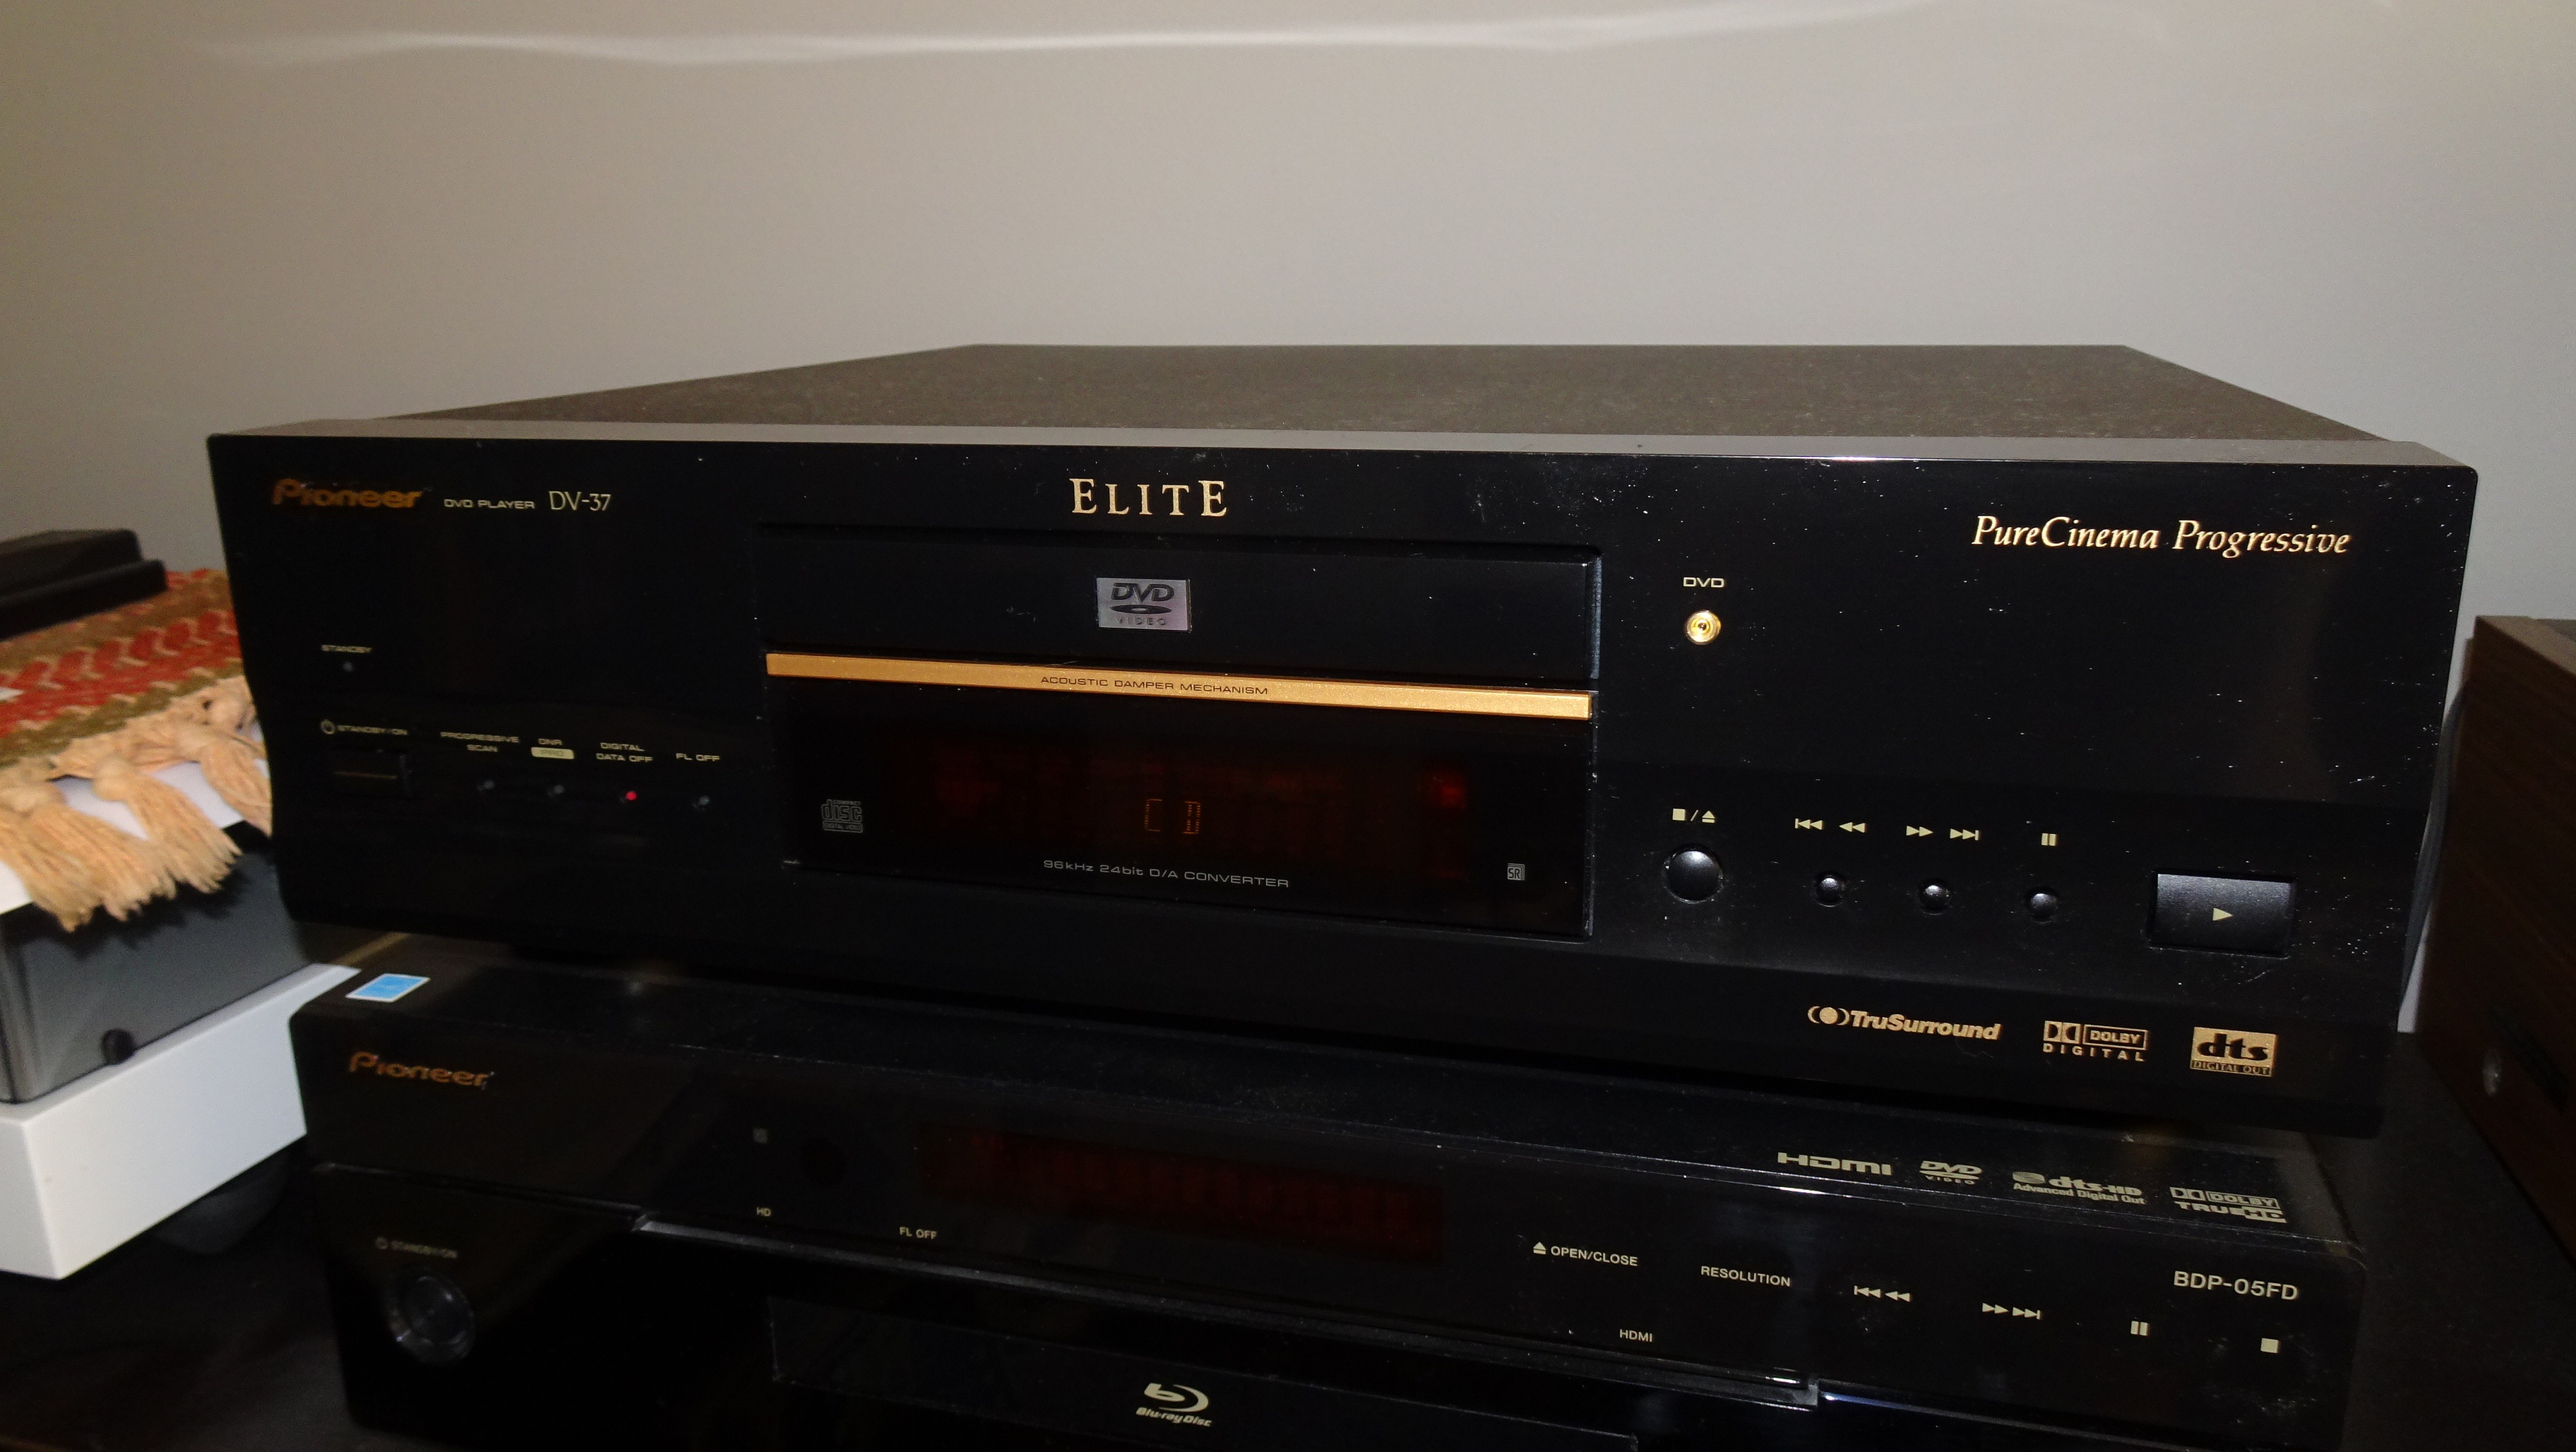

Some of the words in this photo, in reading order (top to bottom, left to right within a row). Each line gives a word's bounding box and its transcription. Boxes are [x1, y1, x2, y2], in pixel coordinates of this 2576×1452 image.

[271, 477, 422, 508] Pioneer
[549, 490, 612, 511] DV-37
[1069, 478, 1227, 517] ELITE
[444, 499, 473, 508] DVD
[477, 499, 535, 509] PLAYER
[1972, 516, 2160, 549] PureCinema
[2171, 520, 2351, 559] Progressive
[1683, 577, 1725, 588] DVD
[1111, 583, 1174, 603] DVD
[1115, 616, 1167, 626] VIDEO
[321, 644, 372, 654] STANDBY
[1041, 676, 1109, 687] ACOUSTIC
[1114, 680, 1174, 691] DAMPER
[1180, 683, 1268, 696] MECHANISM
[440, 732, 520, 743] PROGRESSIVE
[466, 744, 499, 753] SCAN
[600, 742, 645, 752] DIGITAL
[595, 753, 626, 761] DATA
[675, 752, 693, 761] FL
[1044, 859, 1094, 871] 96kHz
[1099, 864, 1144, 876] 24bit
[1149, 868, 1179, 879] D/A
[1183, 871, 1289, 888] CONVERTER
[1851, 1010, 2002, 1041] TruSurround
[2089, 1029, 2142, 1045] DOLBY
[2042, 1042, 2145, 1062] DIGITAL
[2197, 1033, 2268, 1061] dts
[350, 1051, 491, 1088] Pioneer
[2193, 1060, 2239, 1073] DIGITAL
[2243, 1065, 2269, 1075] OUT
[1777, 1151, 1892, 1177] HDMI
[1919, 1160, 1983, 1175] DVD
[1925, 1175, 1976, 1185] VIDEO
[2012, 1182, 2068, 1197] Advanced
[2076, 1189, 2118, 1203] Digital
[2121, 1194, 2147, 1206] Out
[2208, 1192, 2276, 1208] DOLBY
[756, 1207, 773, 1218] HD
[900, 1226, 913, 1237] FL
[916, 1228, 937, 1239] OFF
[1551, 1245, 1638, 1267] OPEN/CLOSE
[1700, 1266, 1791, 1287] RESOLUTION
[2174, 1270, 2298, 1301] BDP-05FD
[1619, 1328, 1653, 1343] HDMI
